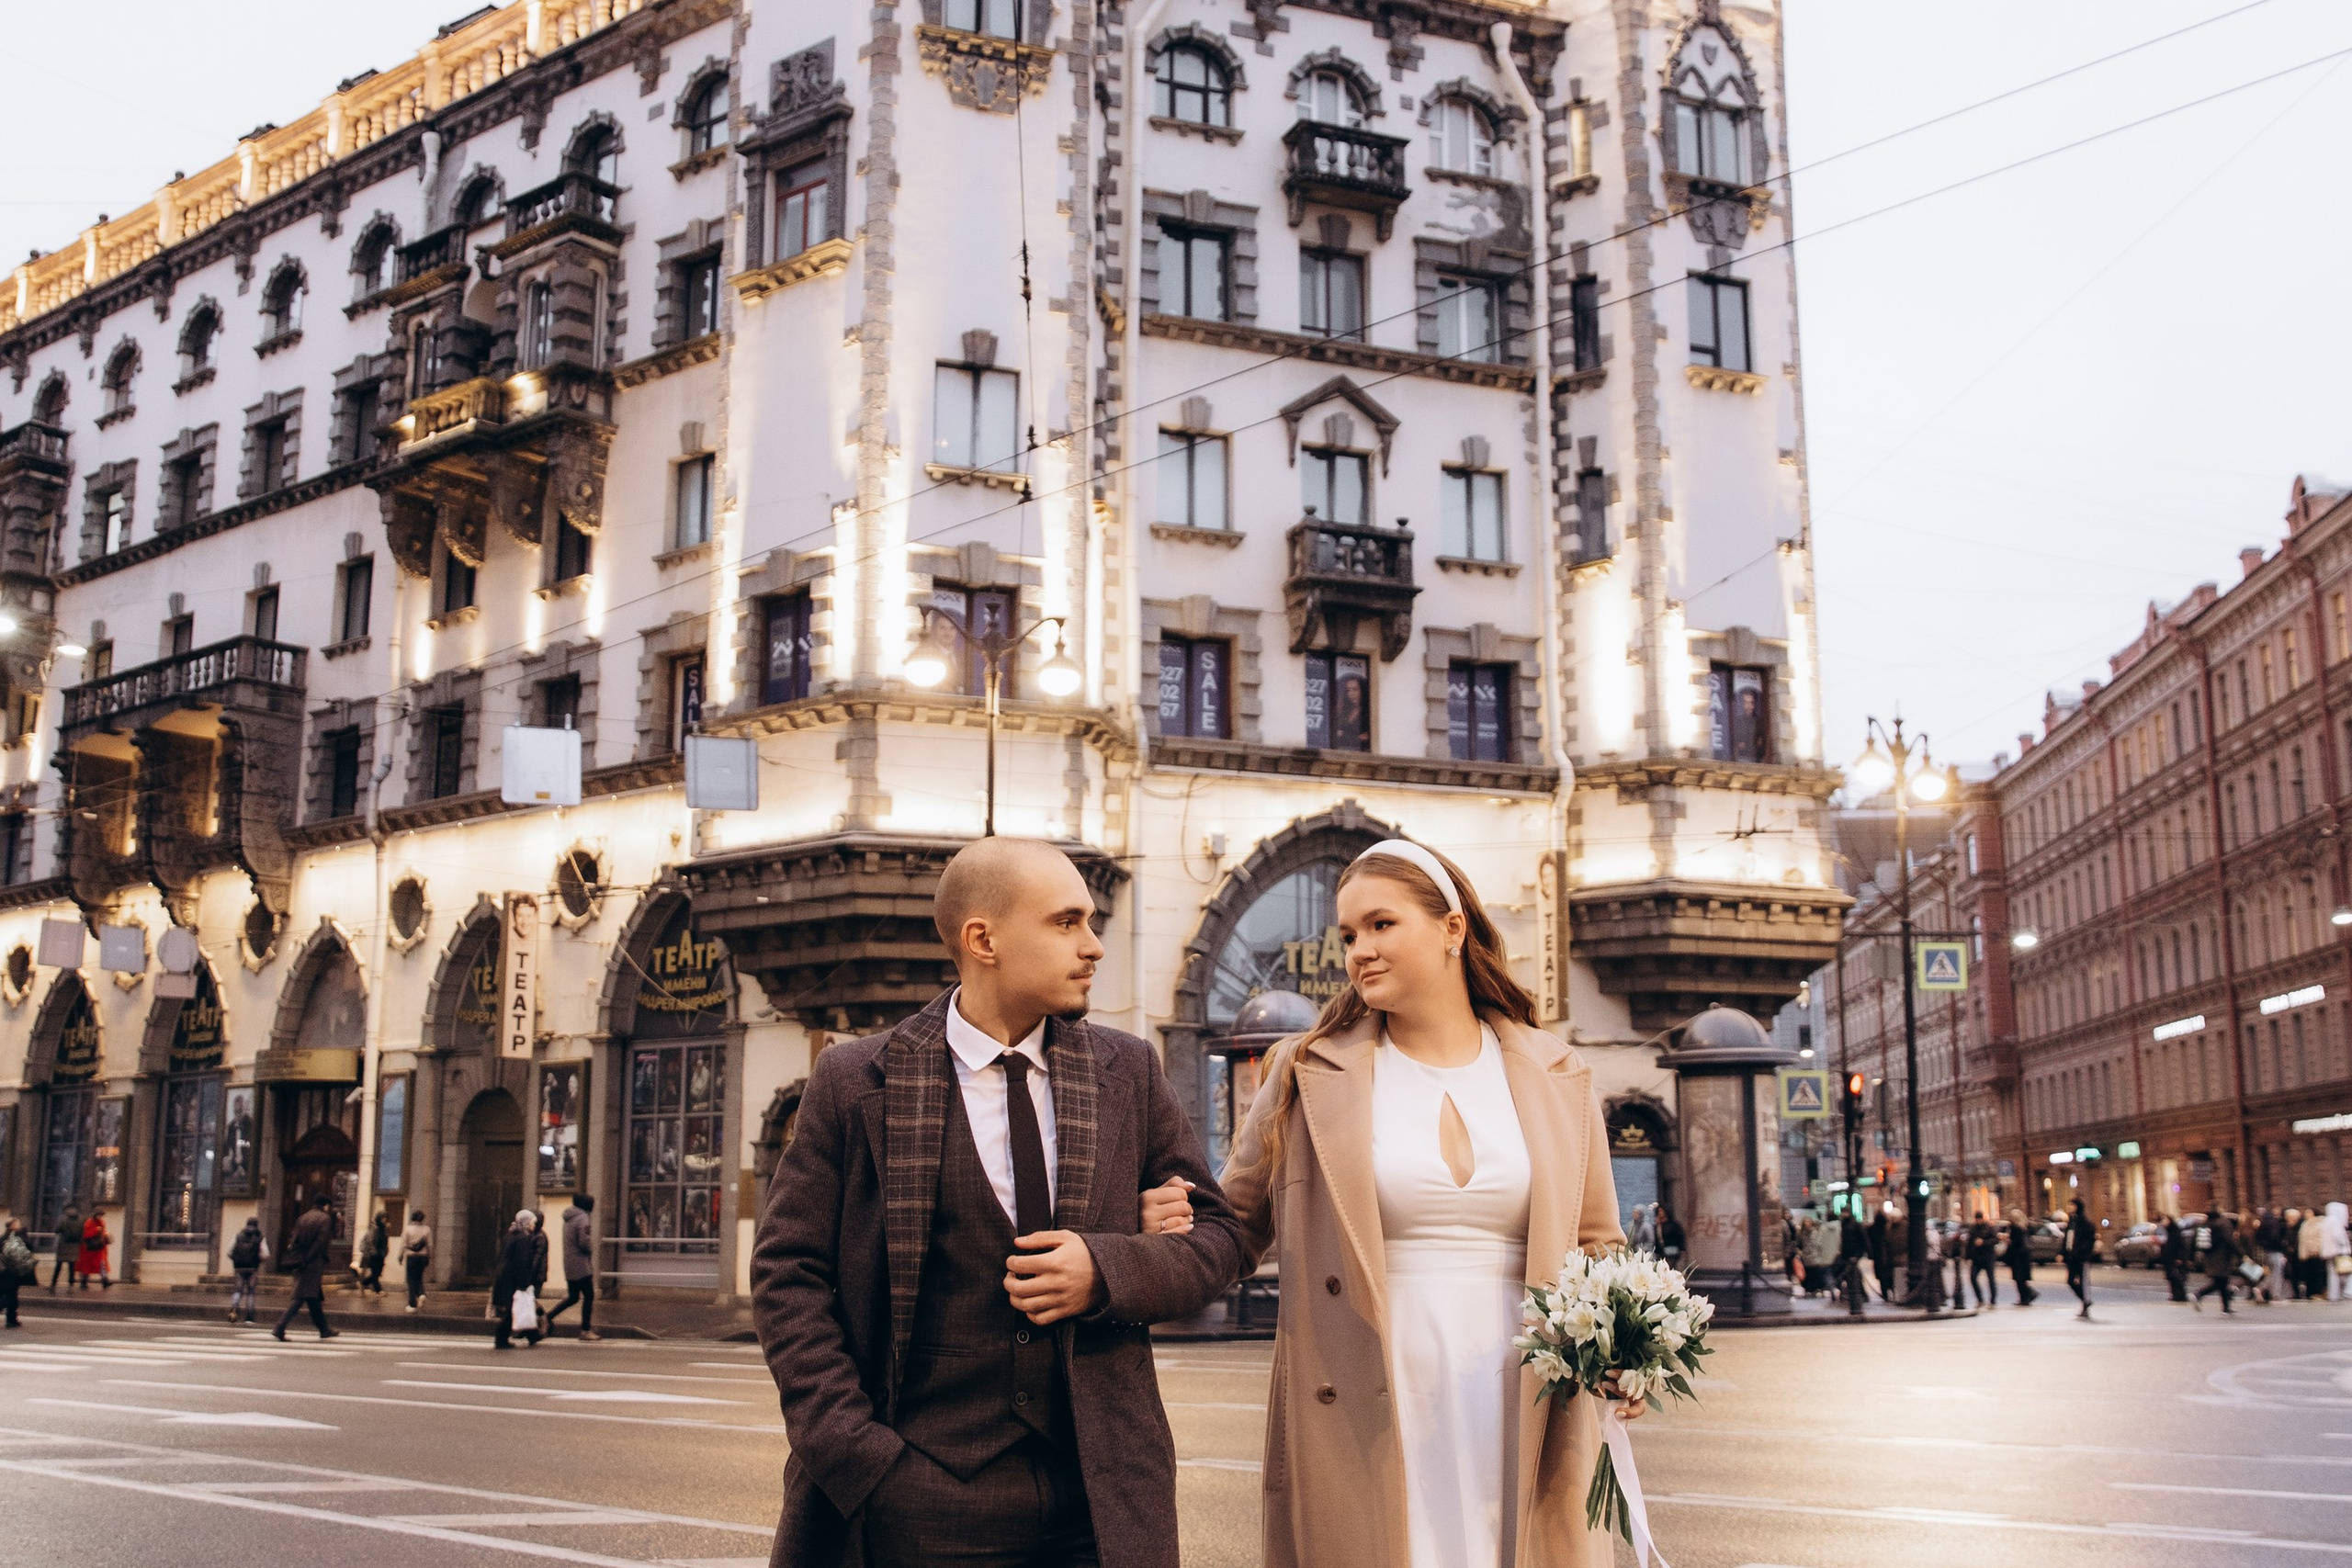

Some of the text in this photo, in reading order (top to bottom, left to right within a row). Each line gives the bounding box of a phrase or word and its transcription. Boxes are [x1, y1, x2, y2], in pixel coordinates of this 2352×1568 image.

[1159, 701, 1181, 716] 67
[1201, 651, 1217, 732] SALE
[1306, 679, 1328, 693] 27
[652, 930, 718, 974] ТЕАТР
[1283, 924, 1346, 975] ТЕА
[1544, 911, 1555, 1014] ТЕАТР
[513, 951, 528, 1051] ТЕАТР
